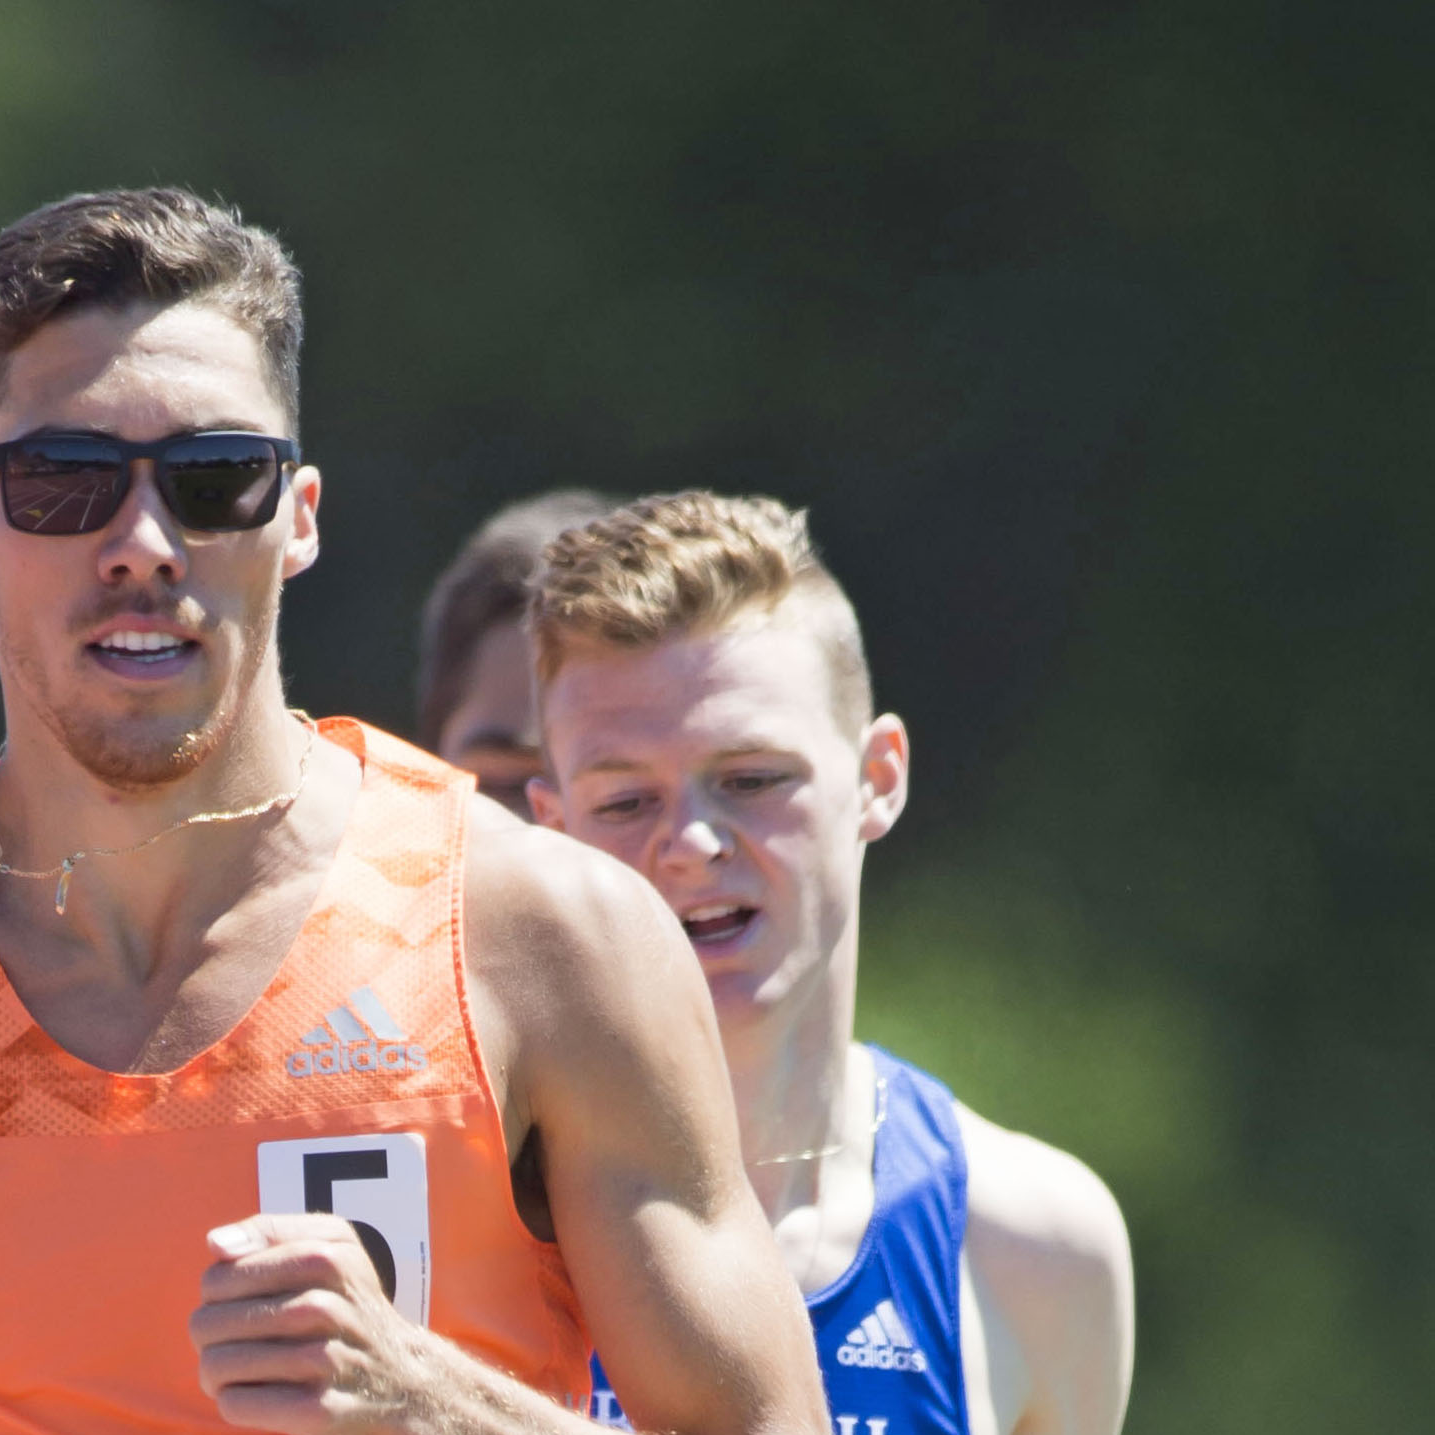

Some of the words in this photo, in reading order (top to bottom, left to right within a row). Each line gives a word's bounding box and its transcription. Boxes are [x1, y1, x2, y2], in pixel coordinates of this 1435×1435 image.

[287, 1034, 427, 1078] adidas
[303, 1149, 397, 1305] 5
[837, 1343, 926, 1373] adidas
